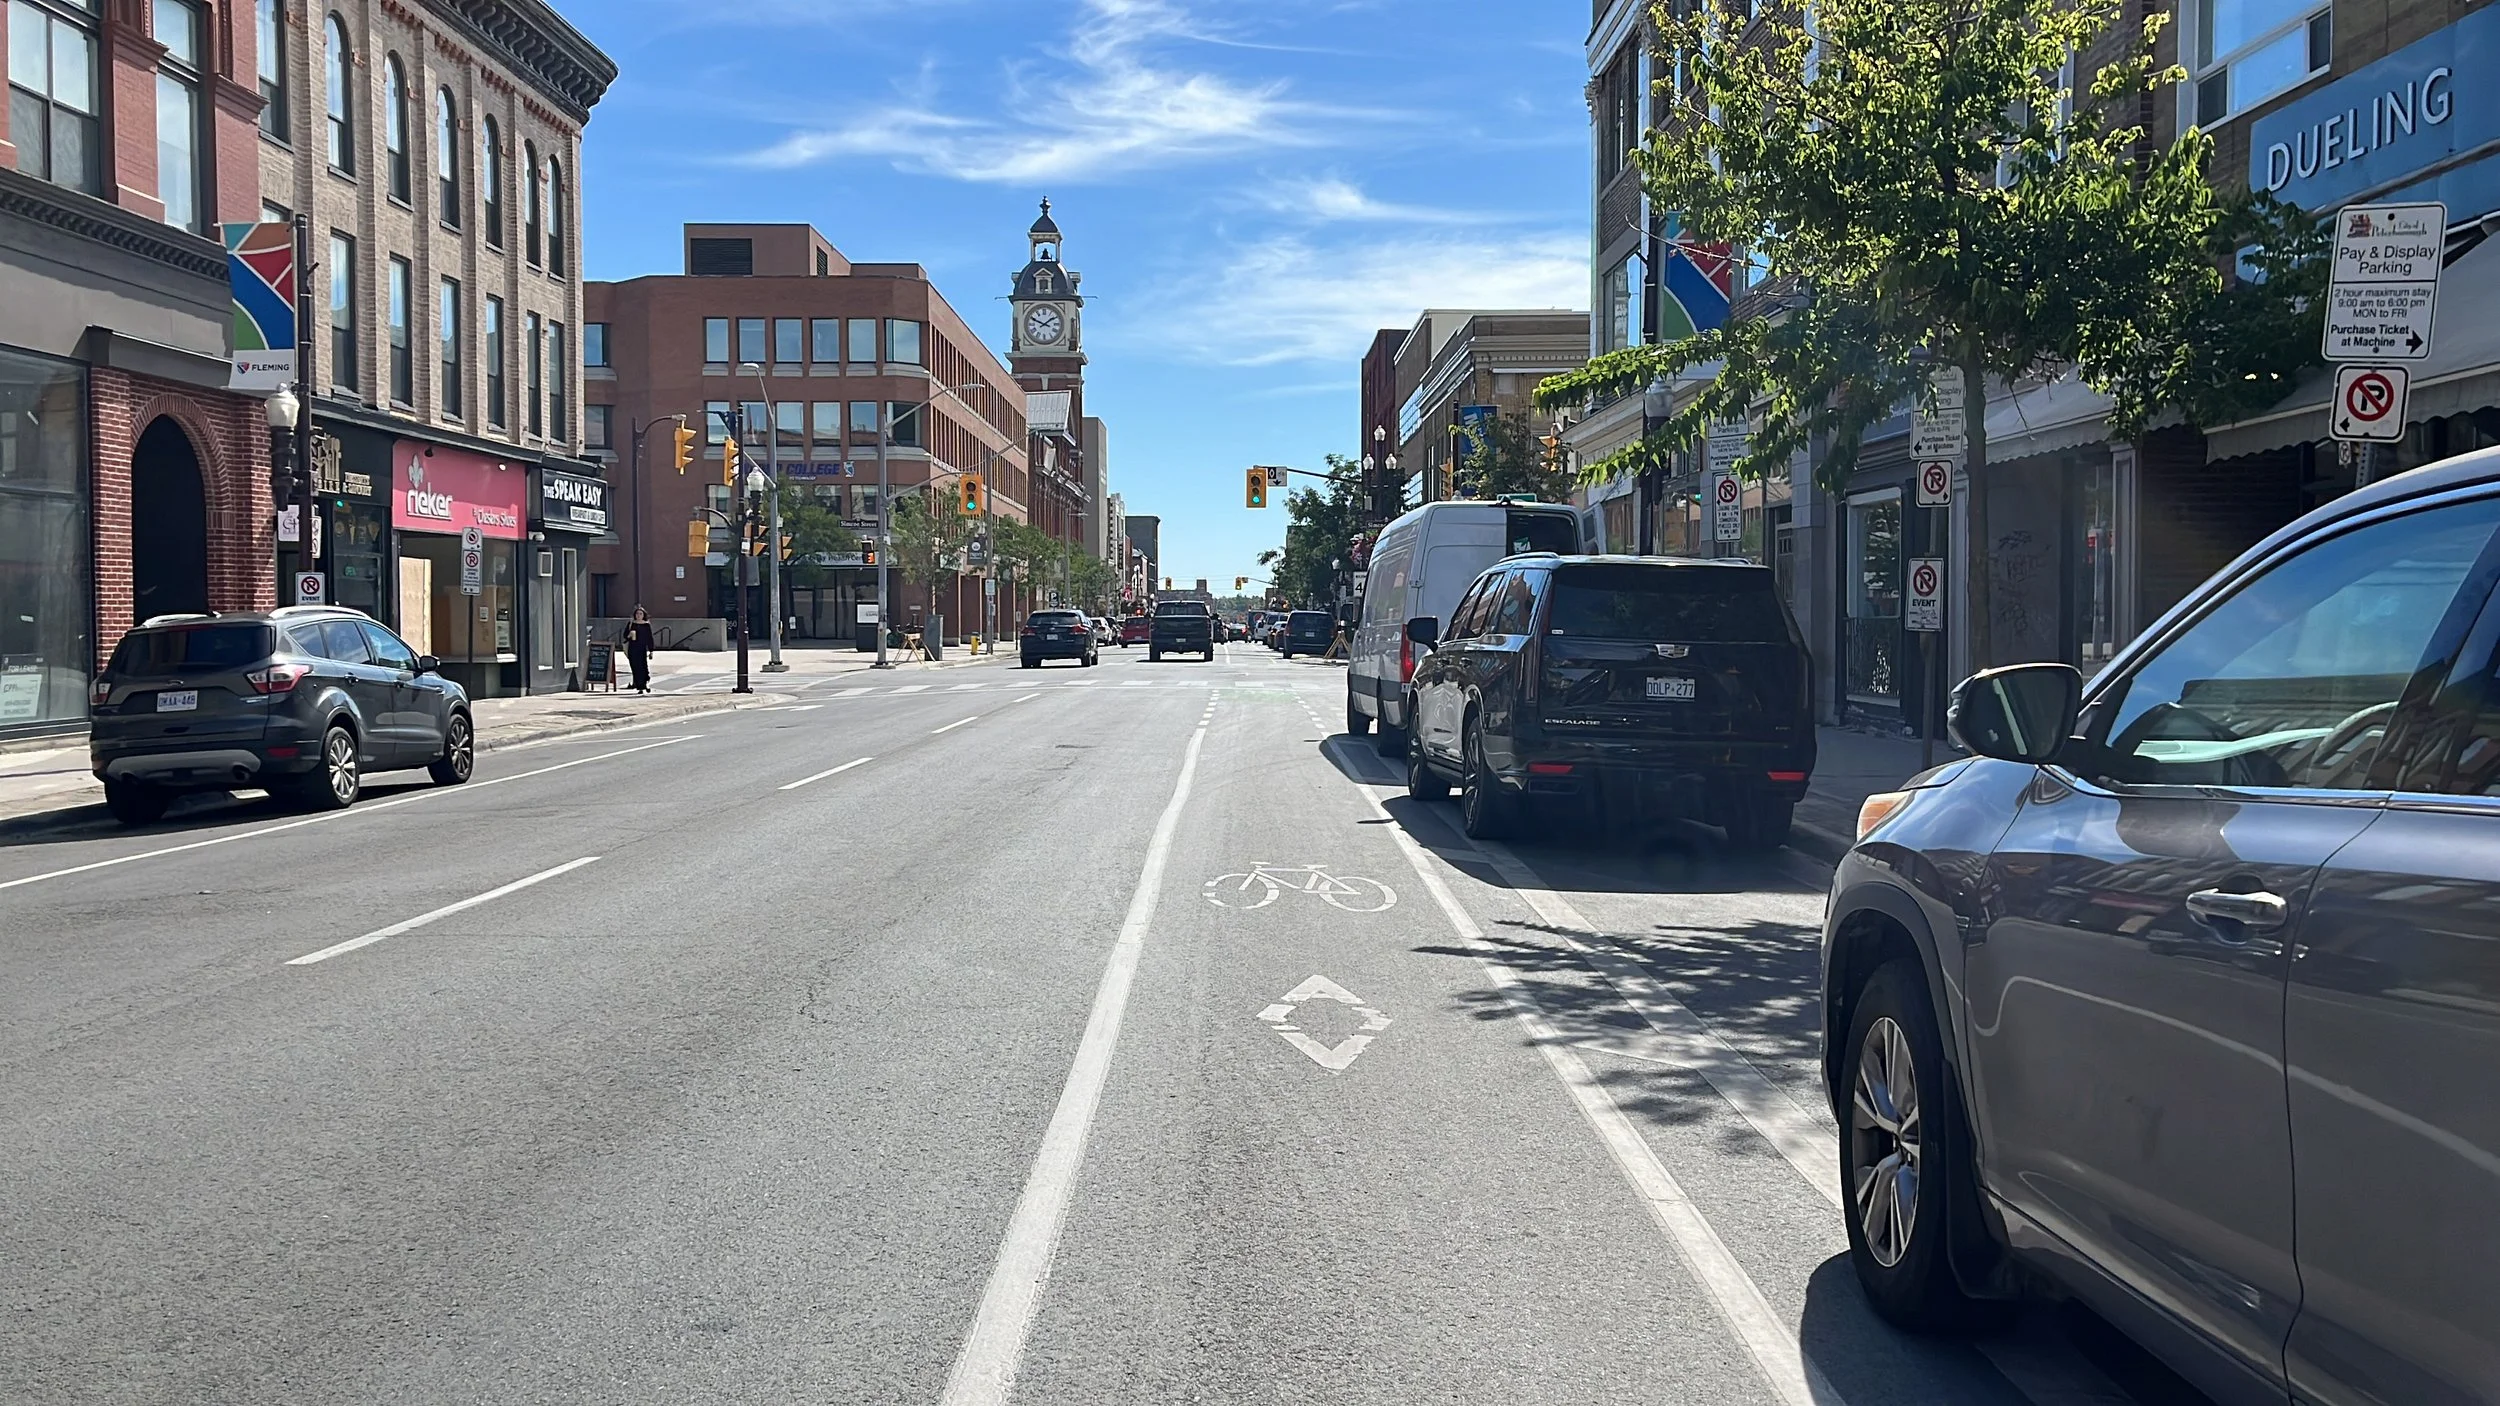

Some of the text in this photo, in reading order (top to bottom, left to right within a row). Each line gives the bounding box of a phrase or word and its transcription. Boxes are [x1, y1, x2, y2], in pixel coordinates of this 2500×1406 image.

[2267, 66, 2452, 192] DUELING
[2372, 223, 2427, 237] Peterborough
[2340, 245, 2436, 262] Pay & Display
[2359, 261, 2412, 276] Parking
[2334, 288, 2432, 298] 2 hour maximum stay
[2338, 298, 2358, 308] 9:00
[2376, 299, 2385, 308] to
[2410, 300, 2426, 309] pm
[2352, 308, 2408, 318] MON to FRI
[2330, 324, 2410, 334] Purchase Ticket
[2341, 336, 2396, 347] at Machine
[787, 464, 840, 476] COLLEGE
[543, 479, 602, 506] THE SPEAK EASY
[407, 482, 453, 517] rieker
[1912, 599, 1936, 607] EVENT
[1676, 683, 1694, 696] 277
